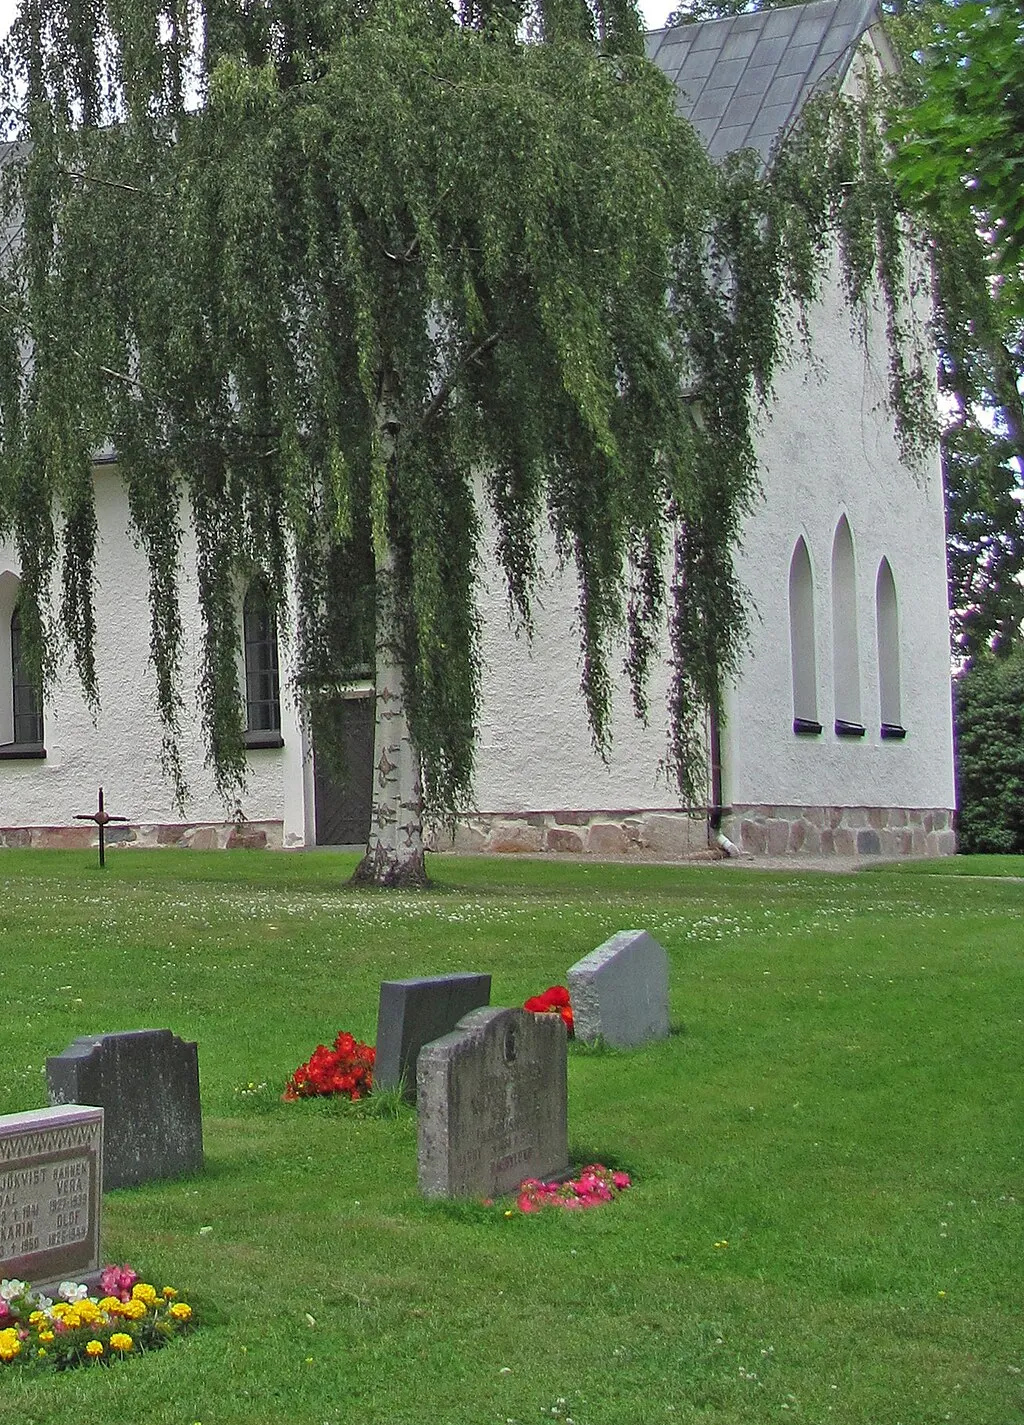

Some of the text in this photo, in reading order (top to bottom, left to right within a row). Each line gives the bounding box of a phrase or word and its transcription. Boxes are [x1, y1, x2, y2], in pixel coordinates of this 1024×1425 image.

[57, 1177, 81, 1194] VERA
[56, 1210, 79, 1228] OLOF
[1, 1220, 32, 1241] KARIN
